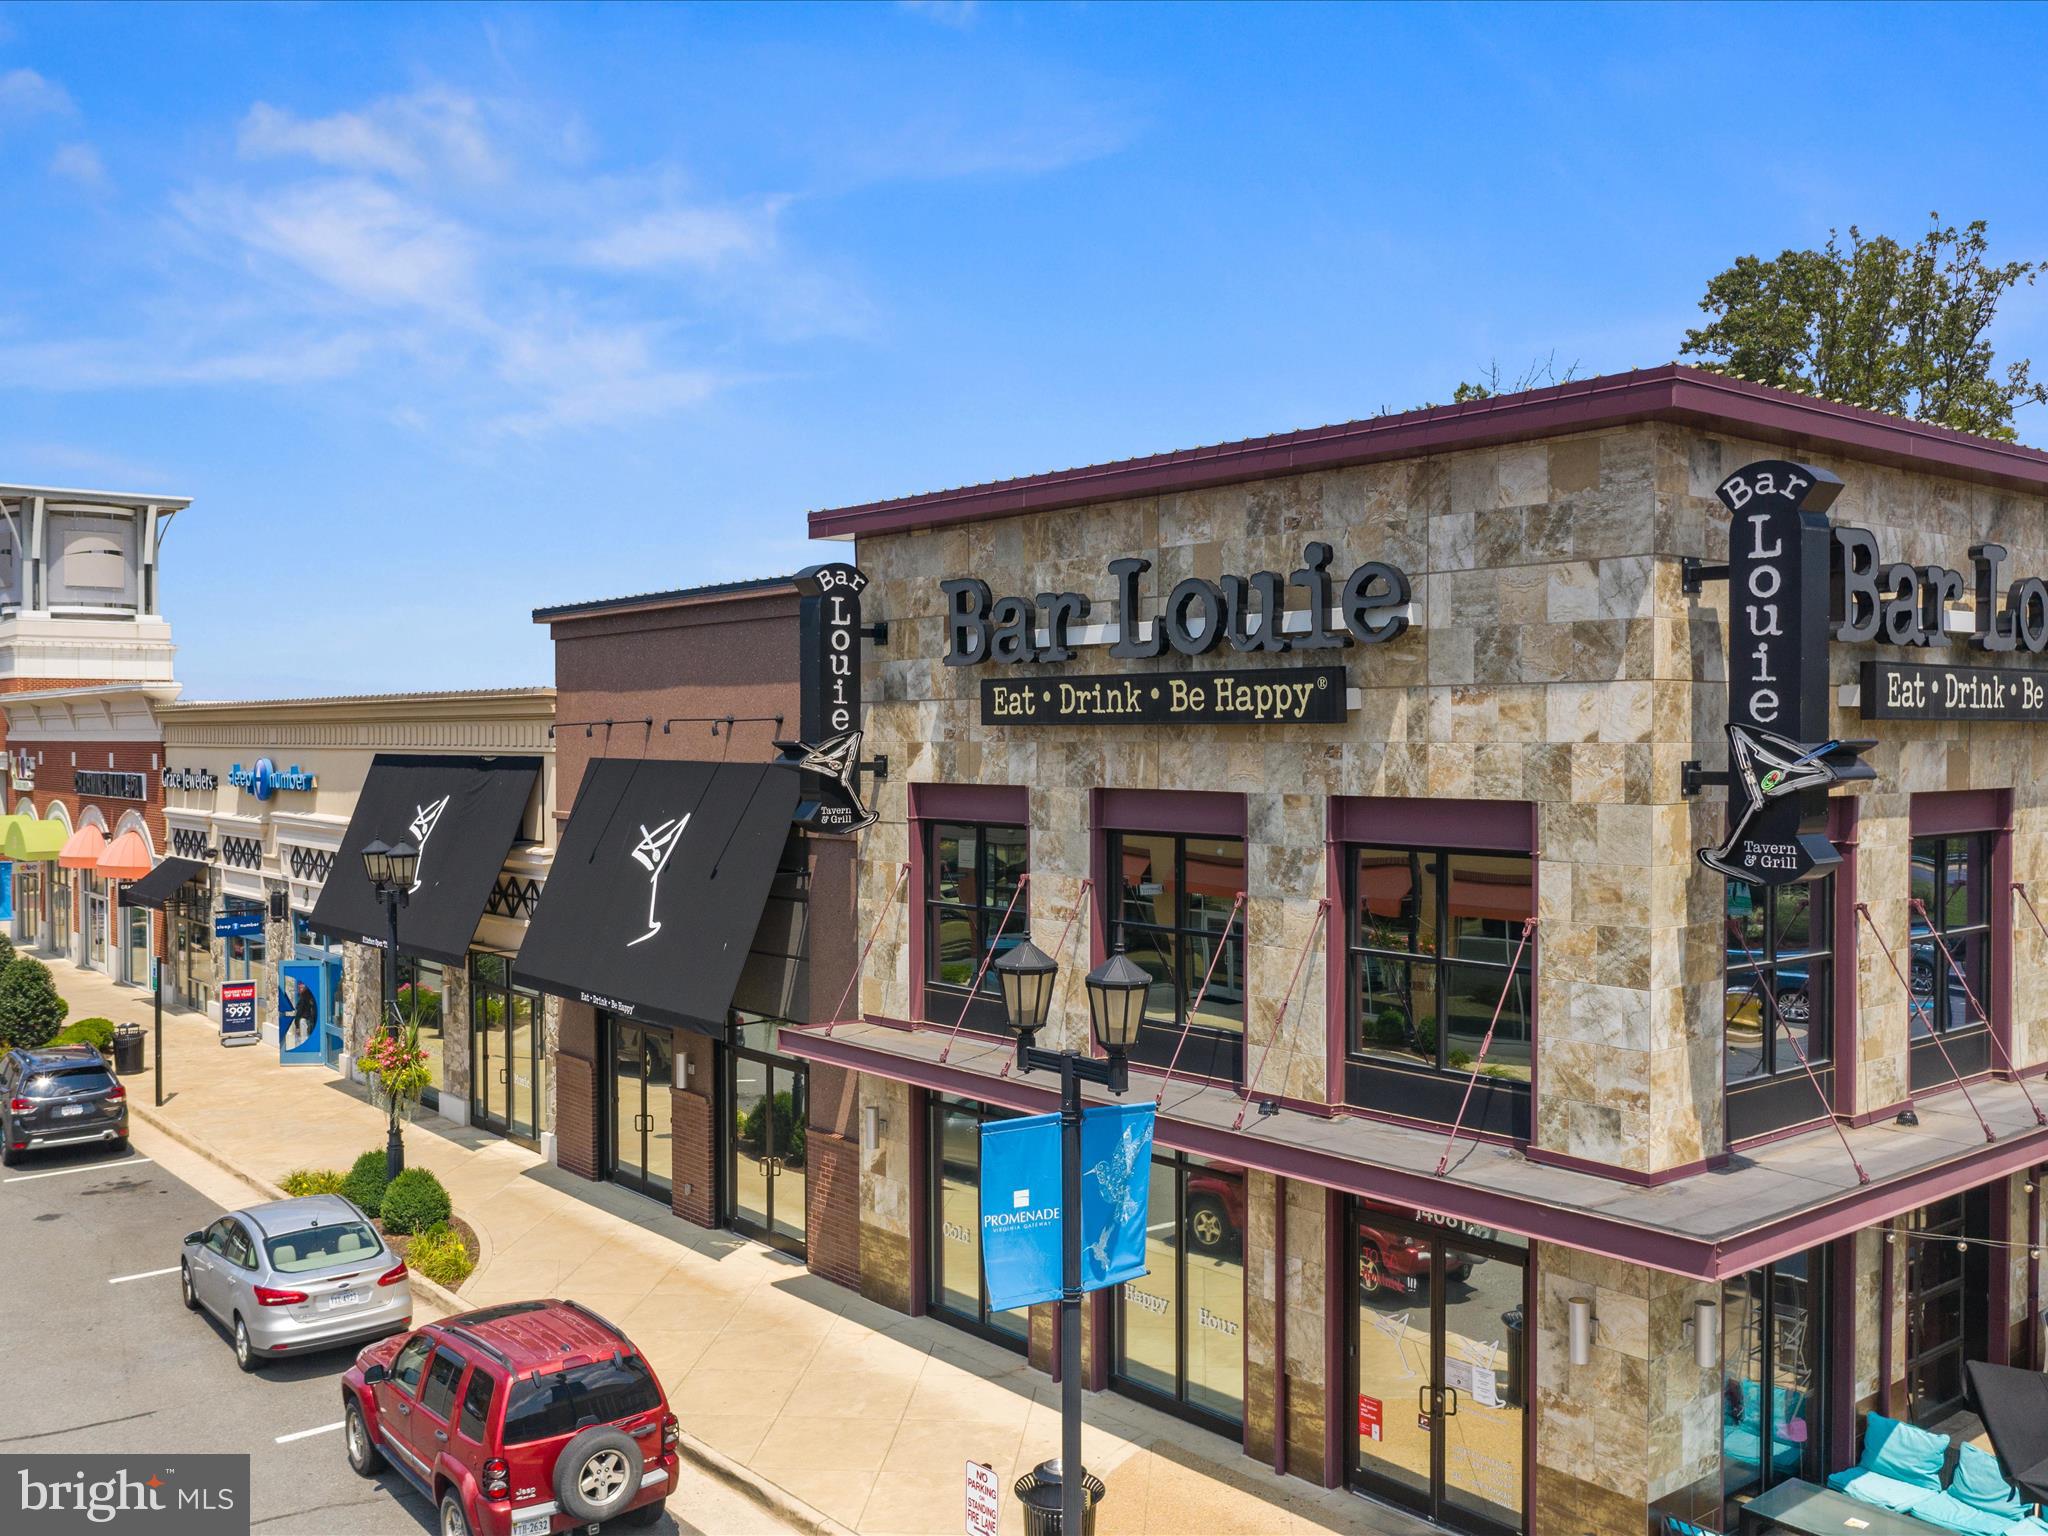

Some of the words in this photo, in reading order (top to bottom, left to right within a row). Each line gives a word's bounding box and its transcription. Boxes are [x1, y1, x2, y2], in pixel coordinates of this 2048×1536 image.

[1722, 472, 1808, 510] Bar
[816, 568, 866, 592] Bar
[1832, 527, 1964, 648] Bar
[940, 577, 1091, 667] Bar
[1109, 541, 1410, 661] Louie
[1746, 514, 1783, 723] Louie
[830, 596, 851, 731] Louie
[993, 685, 1036, 717] Eat
[1059, 681, 1142, 715] Drink
[1170, 679, 1205, 712] Be
[1887, 671, 1926, 709] Eat
[1945, 673, 2006, 710] Drink
[2021, 680, 2045, 710] Be
[161, 767, 182, 789] Grace
[182, 768, 217, 791] Jewelers
[269, 764, 314, 791] number
[820, 806, 852, 815] Tavern
[821, 815, 829, 824] &
[830, 814, 851, 824] Grill
[1744, 840, 1798, 855] Tavern
[1744, 854, 1757, 867] &
[1761, 855, 1798, 870] Grill
[580, 991, 590, 1002] Eat
[592, 994, 608, 1007] Drink
[611, 999, 618, 1009] Be
[983, 1207, 1061, 1228] PROMENADE
[992, 1225, 1021, 1233] VIRGINIA
[1023, 1220, 1052, 1229] GATEWAY
[943, 1221, 971, 1243] Cold
[1124, 1282, 1170, 1316] Happy
[1199, 1306, 1239, 1336] Hour
[976, 1470, 988, 1483] NO
[515, 1487, 536, 1495] Jeep
[967, 1479, 997, 1500] PARKING
[967, 1497, 997, 1520] STANDING
[967, 1509, 980, 1526] FIRE
[981, 1516, 996, 1534] LANE
